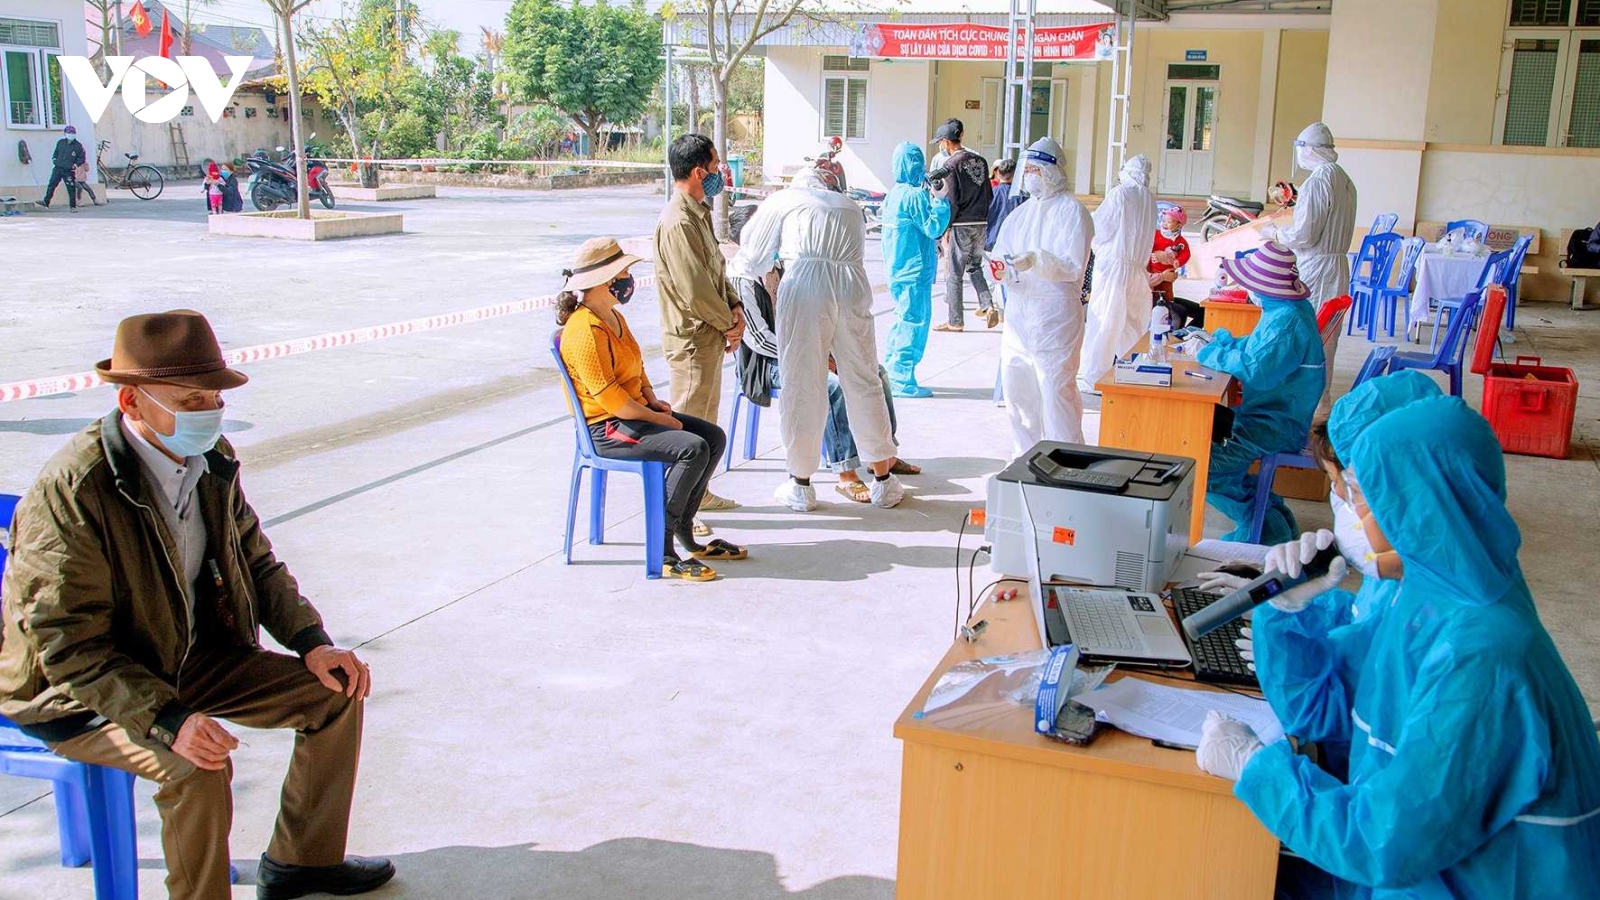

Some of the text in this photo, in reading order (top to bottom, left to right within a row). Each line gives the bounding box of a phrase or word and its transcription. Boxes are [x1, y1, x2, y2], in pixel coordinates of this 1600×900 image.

[893, 28, 916, 40] TOÀN
[918, 28, 937, 40] DÂN
[938, 28, 958, 40] TÍCH
[960, 28, 978, 43] CỰC
[979, 30, 1009, 42] CHUNG
[900, 43, 909, 57] SỰ
[910, 42, 922, 55] LÂY
[923, 43, 936, 55] LAN
[937, 41, 950, 56] CỦA
[951, 44, 967, 57] DỊCH
[968, 45, 988, 57] COVID
[994, 45, 1003, 57] 19
[1043, 43, 1060, 57] HÌNH
[1061, 42, 1075, 57] MỚI
